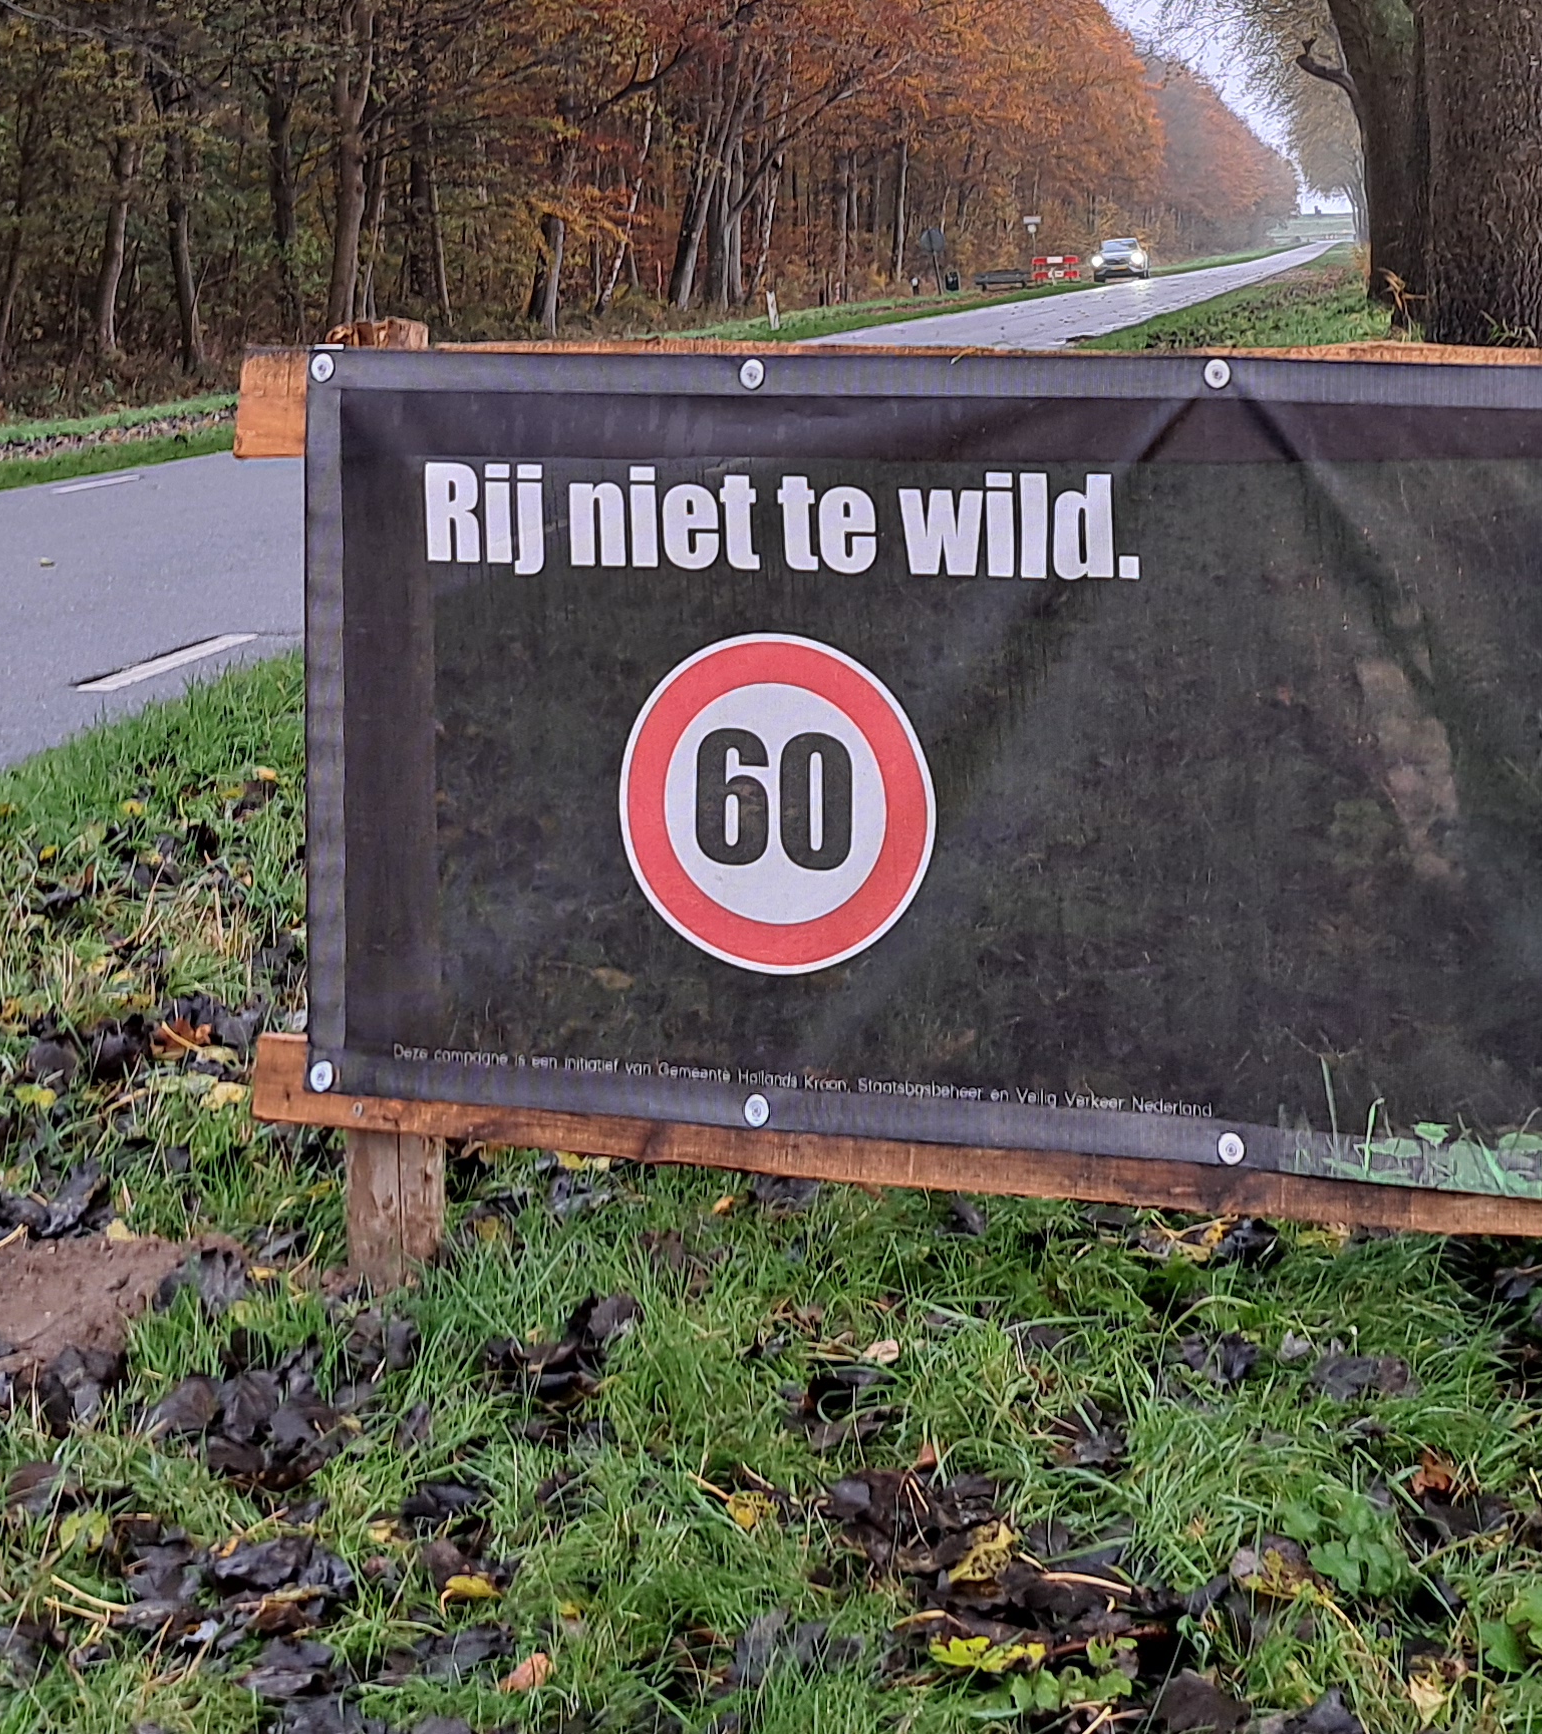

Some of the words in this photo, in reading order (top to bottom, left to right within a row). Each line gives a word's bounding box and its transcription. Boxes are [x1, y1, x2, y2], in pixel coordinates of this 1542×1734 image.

[424, 462, 544, 576] Rij
[570, 466, 760, 571] niet
[778, 474, 877, 572] te
[899, 471, 1142, 580] wild.
[695, 727, 855, 870] 60
[393, 1043, 428, 1061] Deze
[433, 1049, 508, 1068] campagne
[515, 1054, 526, 1067] is
[532, 1057, 558, 1069] een
[564, 1057, 619, 1073] initiatief
[625, 1061, 652, 1075] van
[658, 1061, 731, 1083] Gemeente
[738, 1068, 798, 1088] Hollands
[858, 1077, 984, 1101] Staatsbosbeheer
[990, 1088, 1009, 1102] en
[1016, 1086, 1057, 1108] Veilig
[1064, 1090, 1125, 1111] Verkeer
